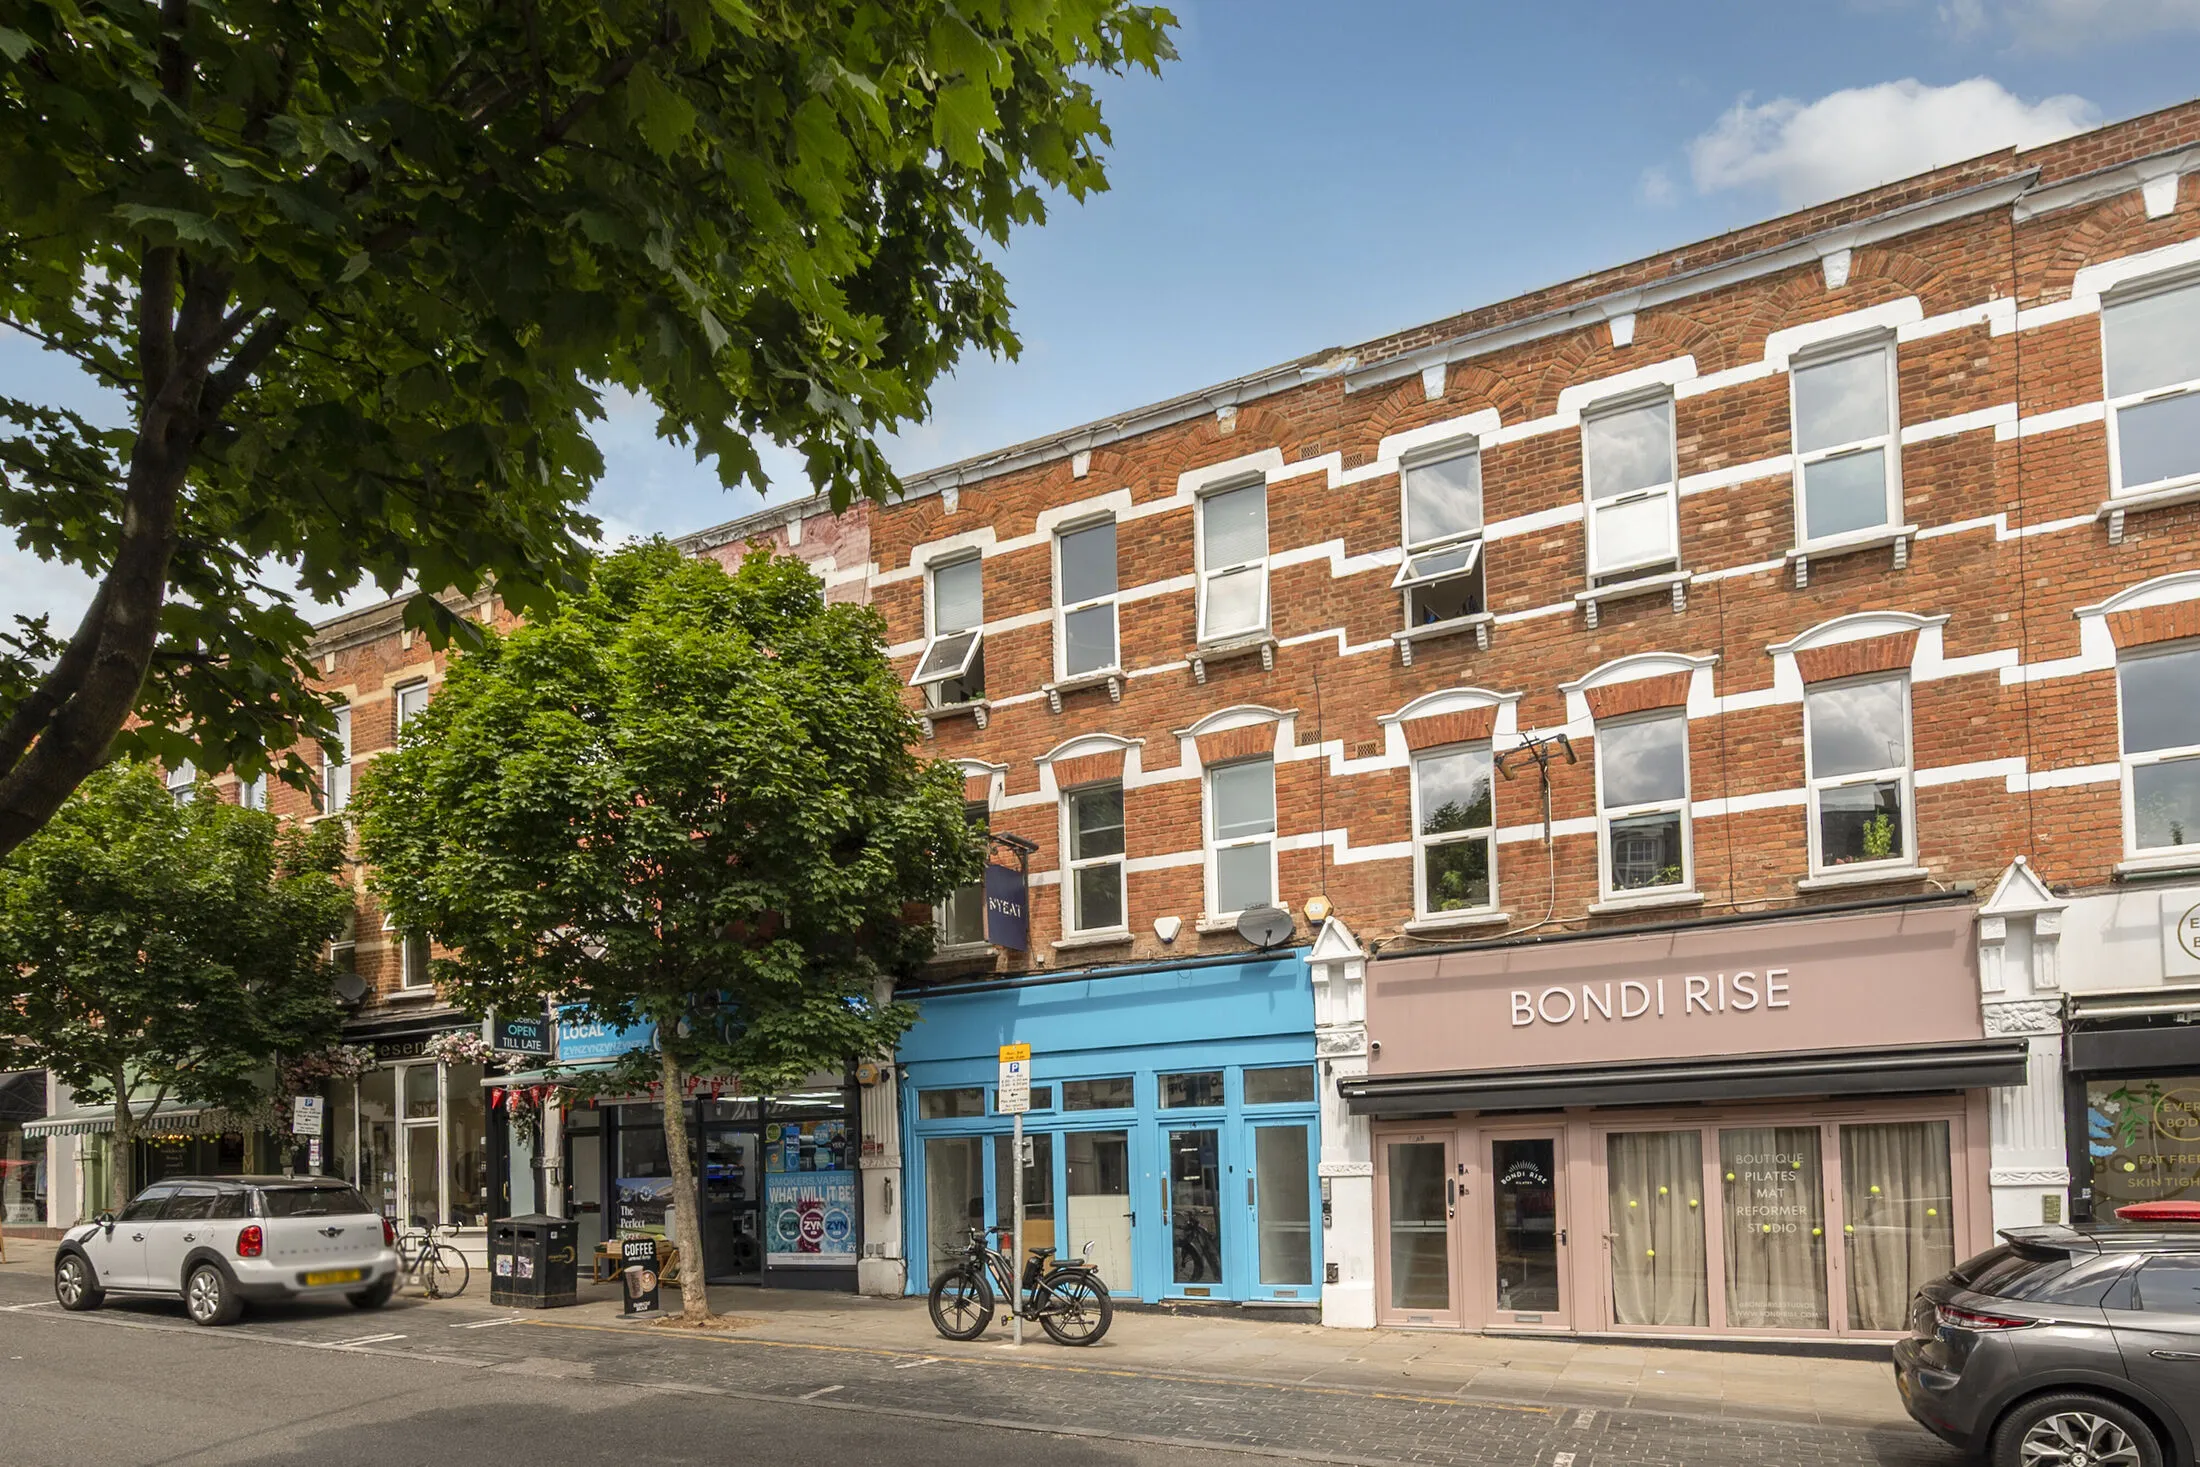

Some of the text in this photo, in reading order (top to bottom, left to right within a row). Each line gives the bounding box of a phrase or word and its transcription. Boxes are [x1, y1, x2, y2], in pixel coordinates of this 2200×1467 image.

[1510, 968, 1791, 1026] BONDI RISE
[507, 1024, 537, 1037] OPEN
[562, 1023, 605, 1041] LOCAL
[502, 1036, 542, 1051] TILL LATE
[1736, 1153, 1804, 1165] BOUTIQUE
[2139, 1155, 2164, 1164] FAT
[1500, 1171, 1526, 1185] BONDI
[1744, 1171, 1796, 1182] PILATES
[2128, 1177, 2161, 1187] SKIN
[769, 1187, 798, 1202] WHAT
[800, 1186, 824, 1202] WILL
[826, 1186, 837, 1201] IT
[1756, 1188, 1785, 1198] MAT
[620, 1205, 634, 1216] The
[1736, 1206, 1807, 1216] REFORMER
[620, 1218, 645, 1229] Perfect
[827, 1221, 848, 1230] ZYN
[624, 1242, 654, 1256] COFFEE
